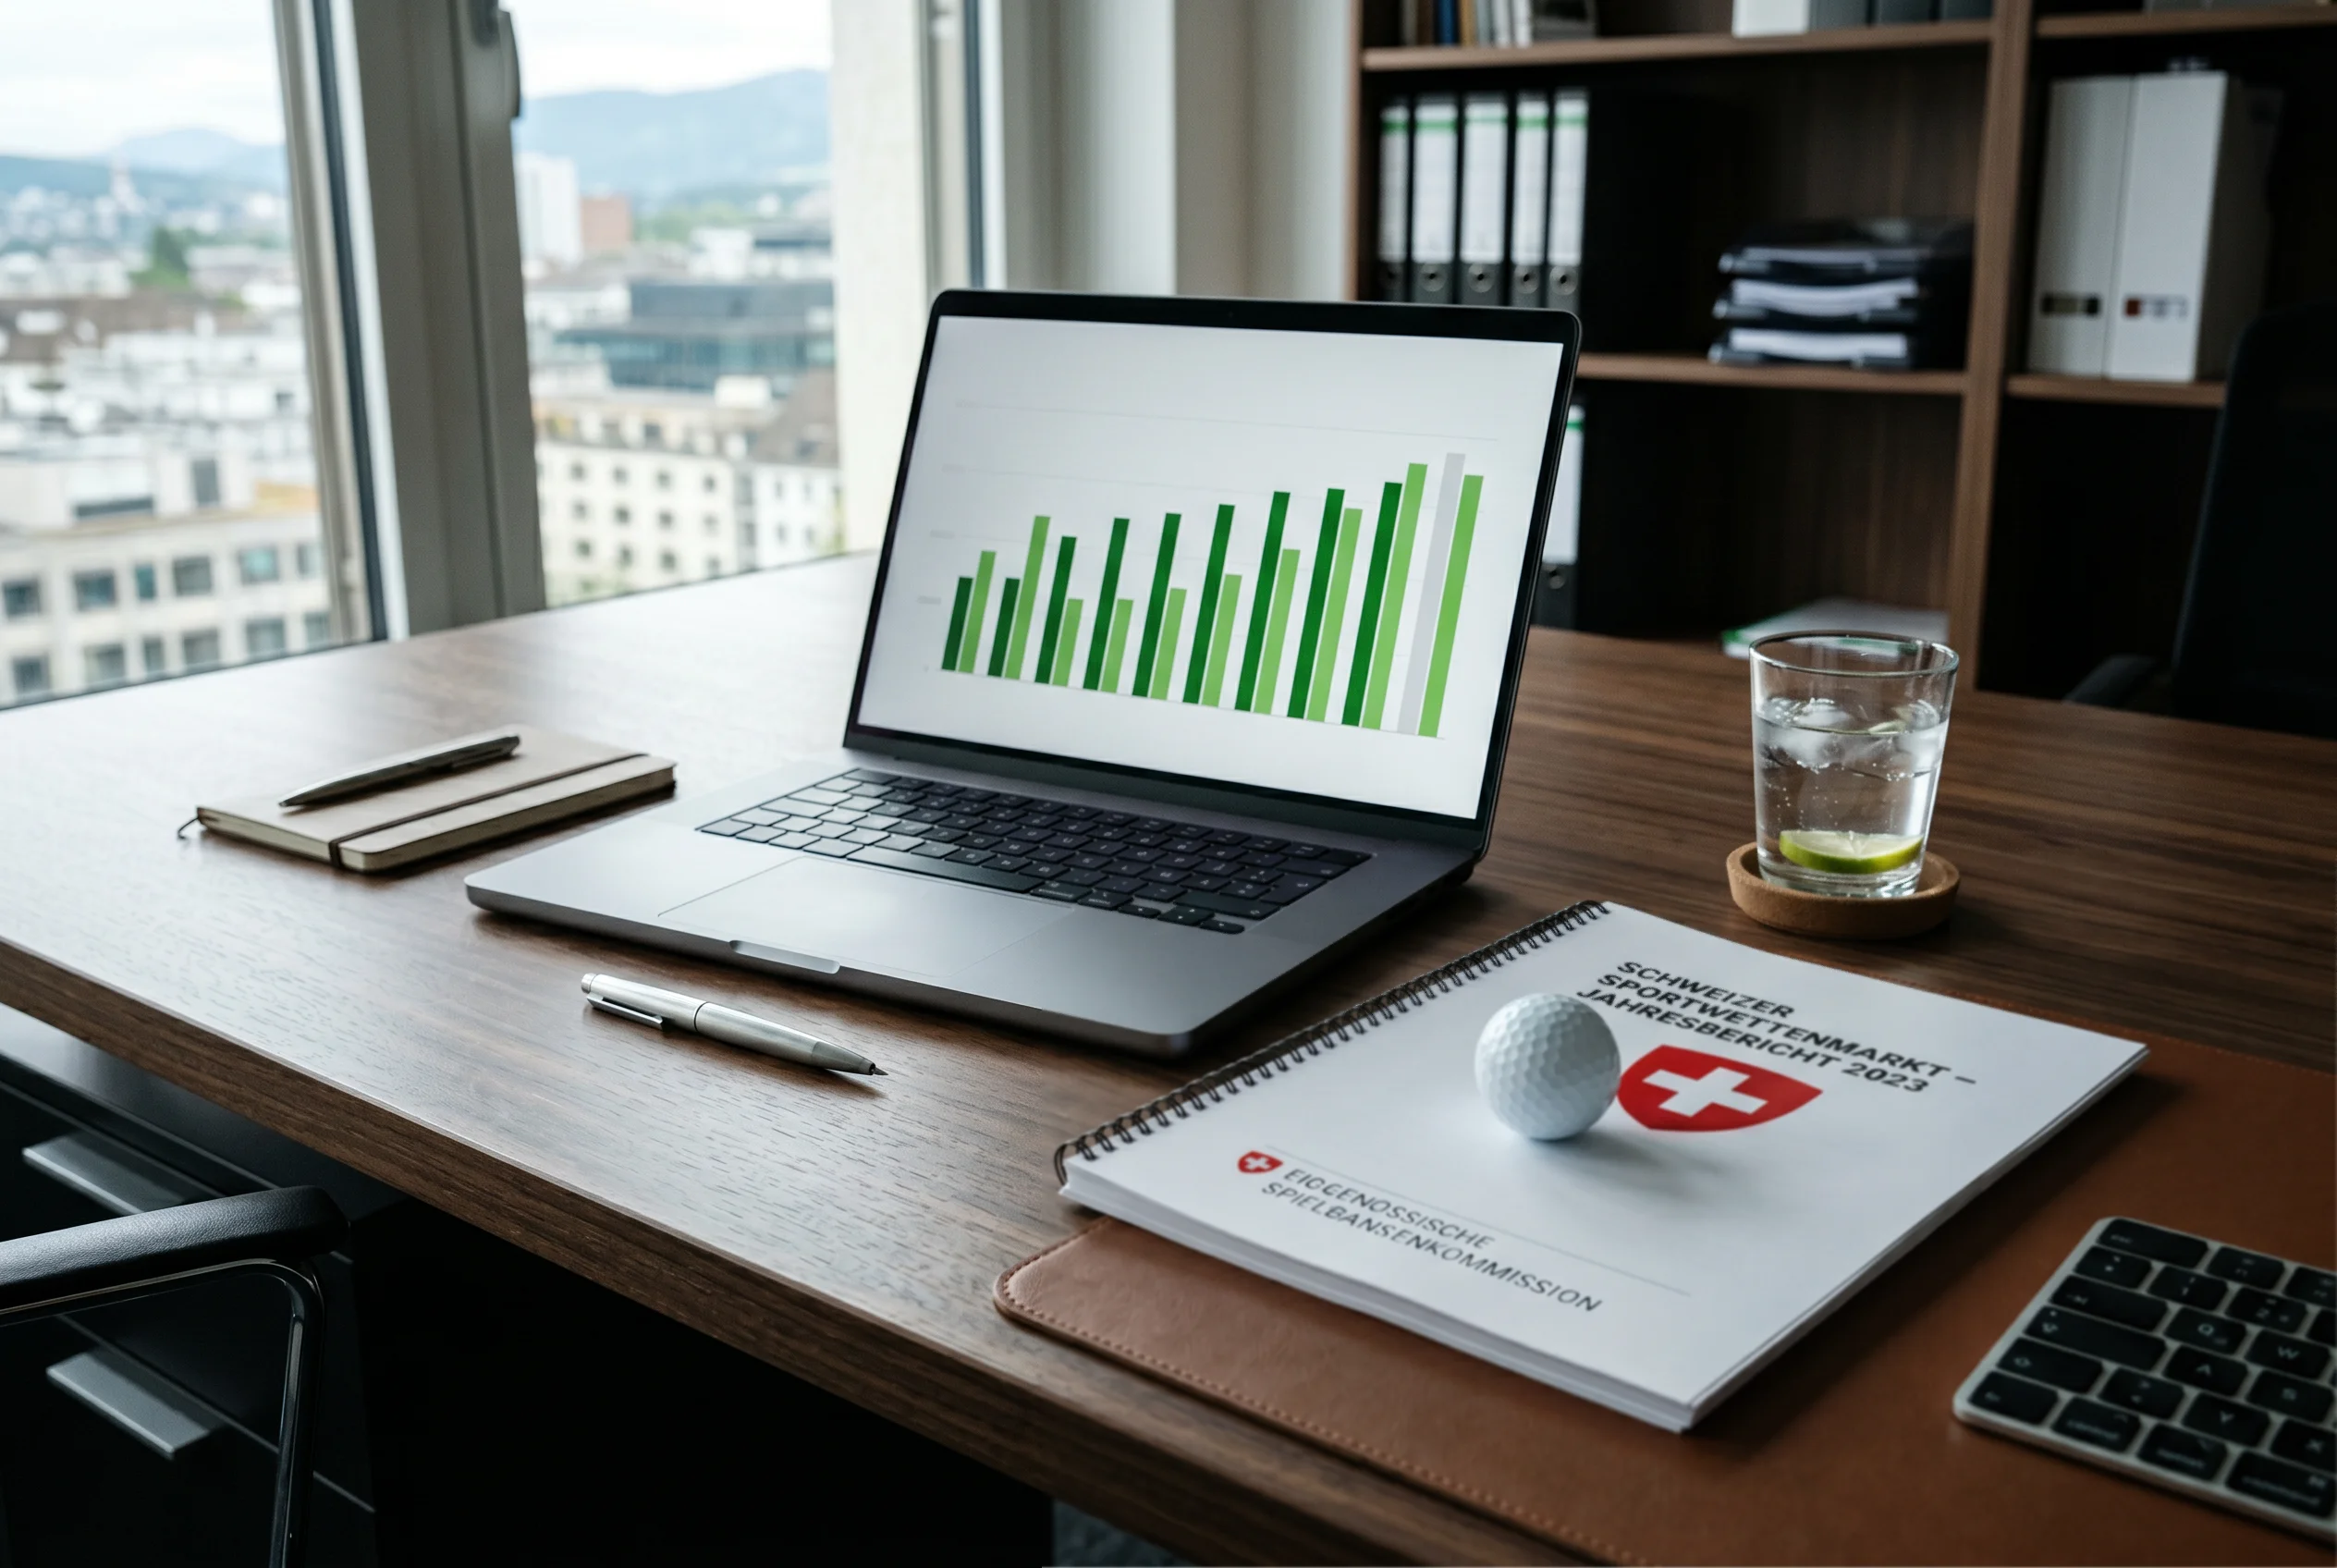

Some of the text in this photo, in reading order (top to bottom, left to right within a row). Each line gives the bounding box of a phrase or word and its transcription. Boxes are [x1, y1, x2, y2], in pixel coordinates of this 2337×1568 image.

[1575, 988, 1930, 1093] JAHRESBERICHT 2023
[1597, 974, 1952, 1078] SPORTWETTENMARKT
[1616, 961, 1795, 1019] SCHWEIZER
[1261, 1182, 1603, 1312] SPIELBANSENKOMMISSION
